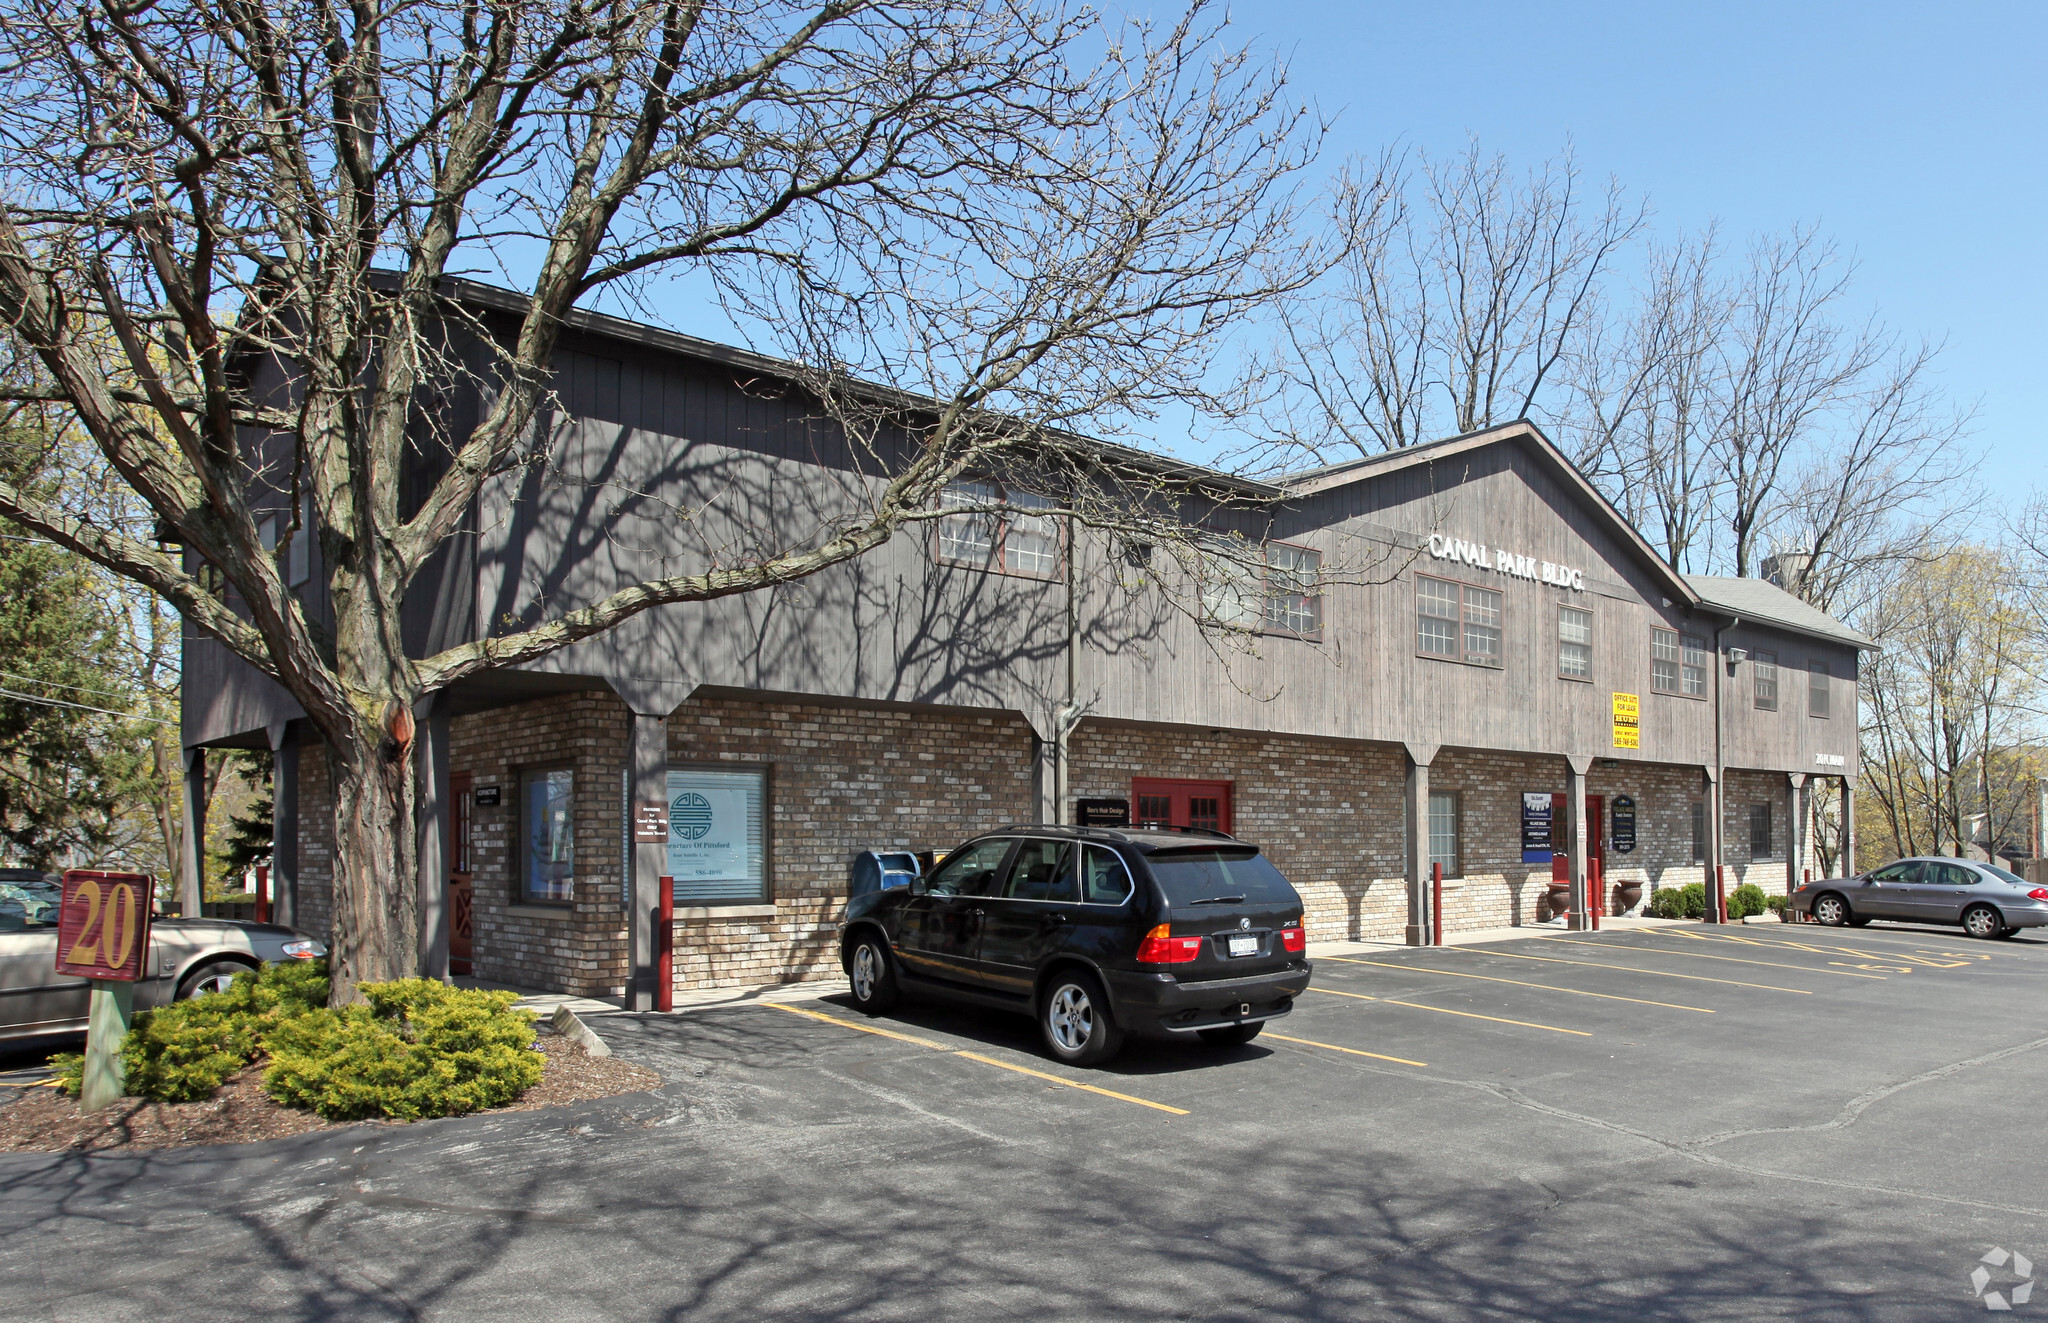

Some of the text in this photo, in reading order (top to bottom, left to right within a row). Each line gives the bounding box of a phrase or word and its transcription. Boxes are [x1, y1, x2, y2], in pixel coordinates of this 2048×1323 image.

[1428, 534, 1585, 590] CANAL PARK BLDG.
[1614, 694, 1628, 703] OFFICE
[1617, 703, 1625, 711] FOR
[1615, 714, 1638, 723] HUNT
[1815, 753, 1824, 765] 20
[1830, 754, 1845, 766] MAIN
[1109, 807, 1125, 816] Design
[65, 880, 136, 969] 20
[1283, 920, 1298, 928] X5
